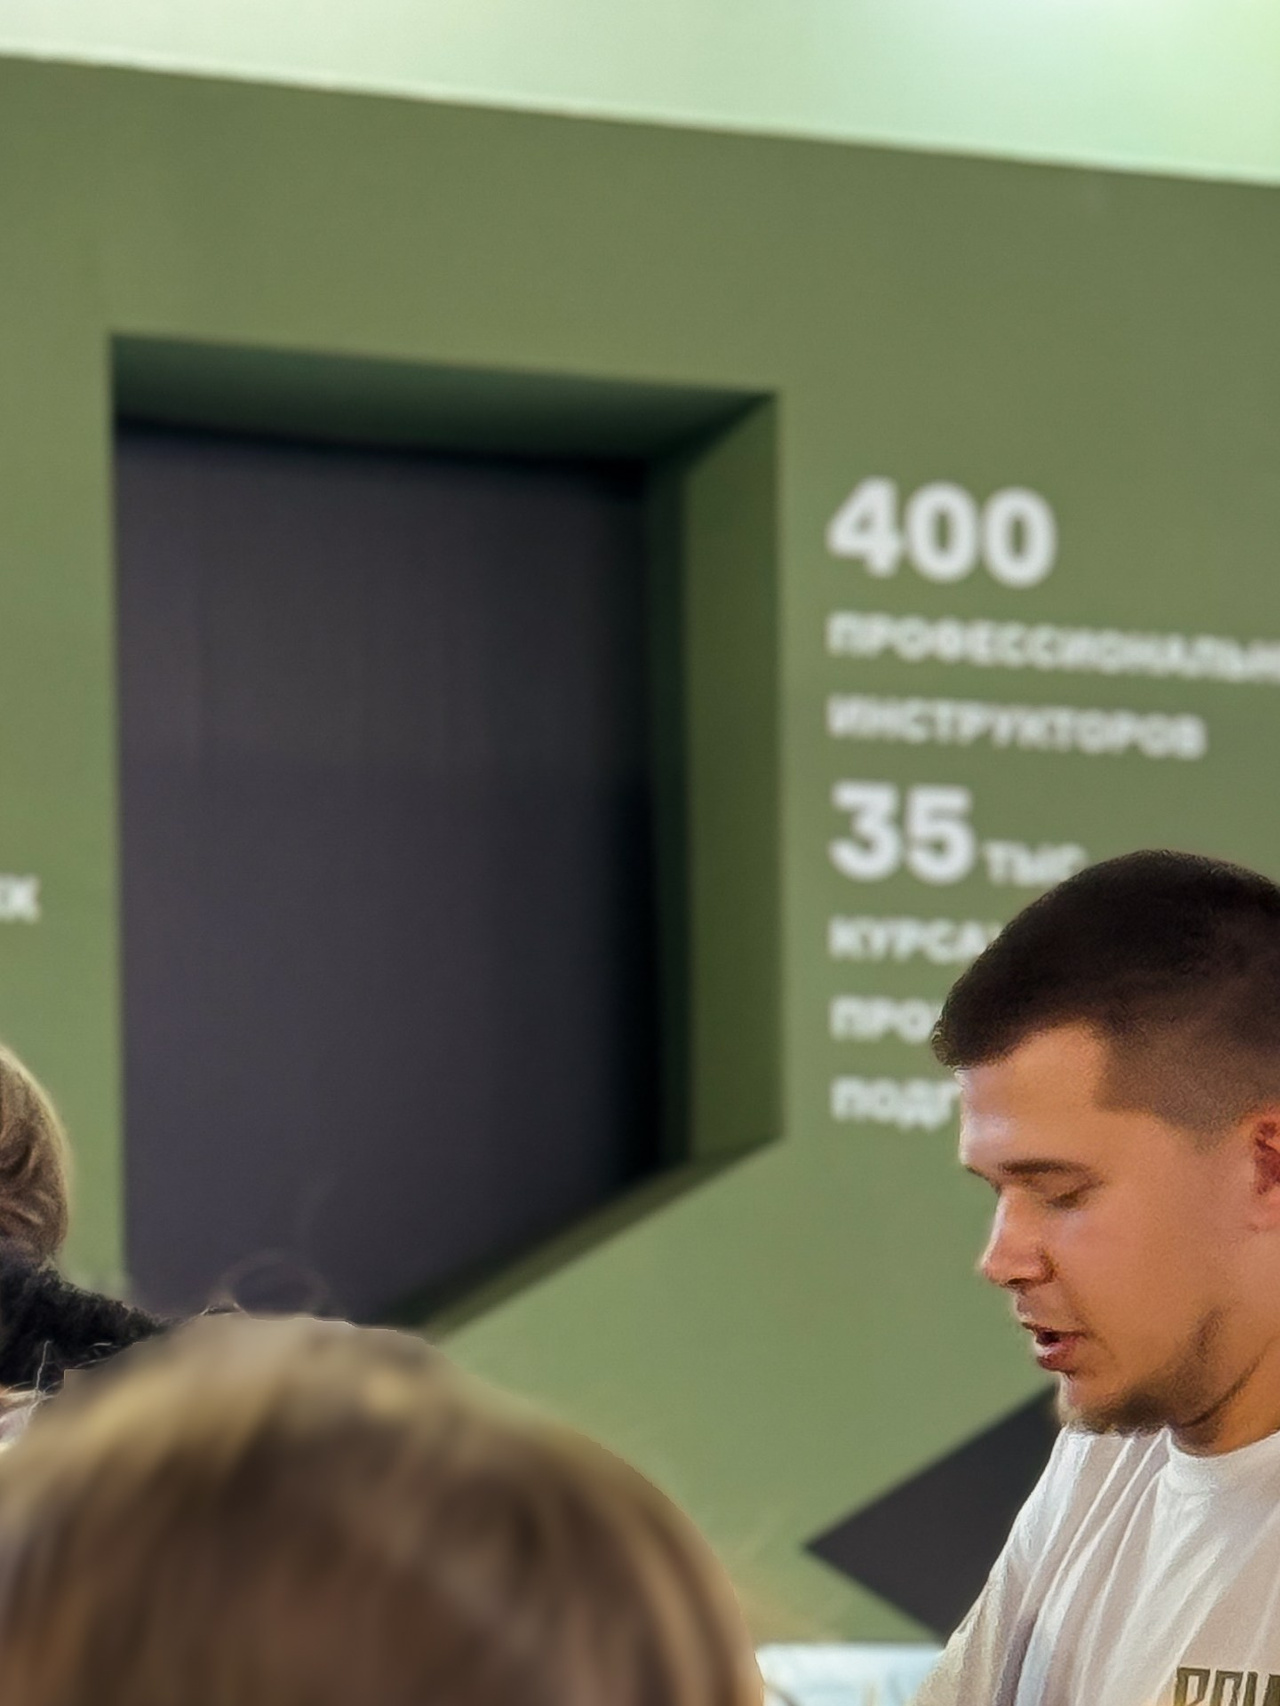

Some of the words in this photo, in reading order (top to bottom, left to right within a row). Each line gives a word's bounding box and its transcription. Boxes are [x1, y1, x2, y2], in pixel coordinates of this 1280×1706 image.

[826, 477, 1056, 586] 400
[826, 694, 1207, 760] ИНСТРУКТОРОВ
[830, 780, 974, 884] 35
[829, 915, 1003, 963] КУРСА
[829, 995, 944, 1043] ПРО
